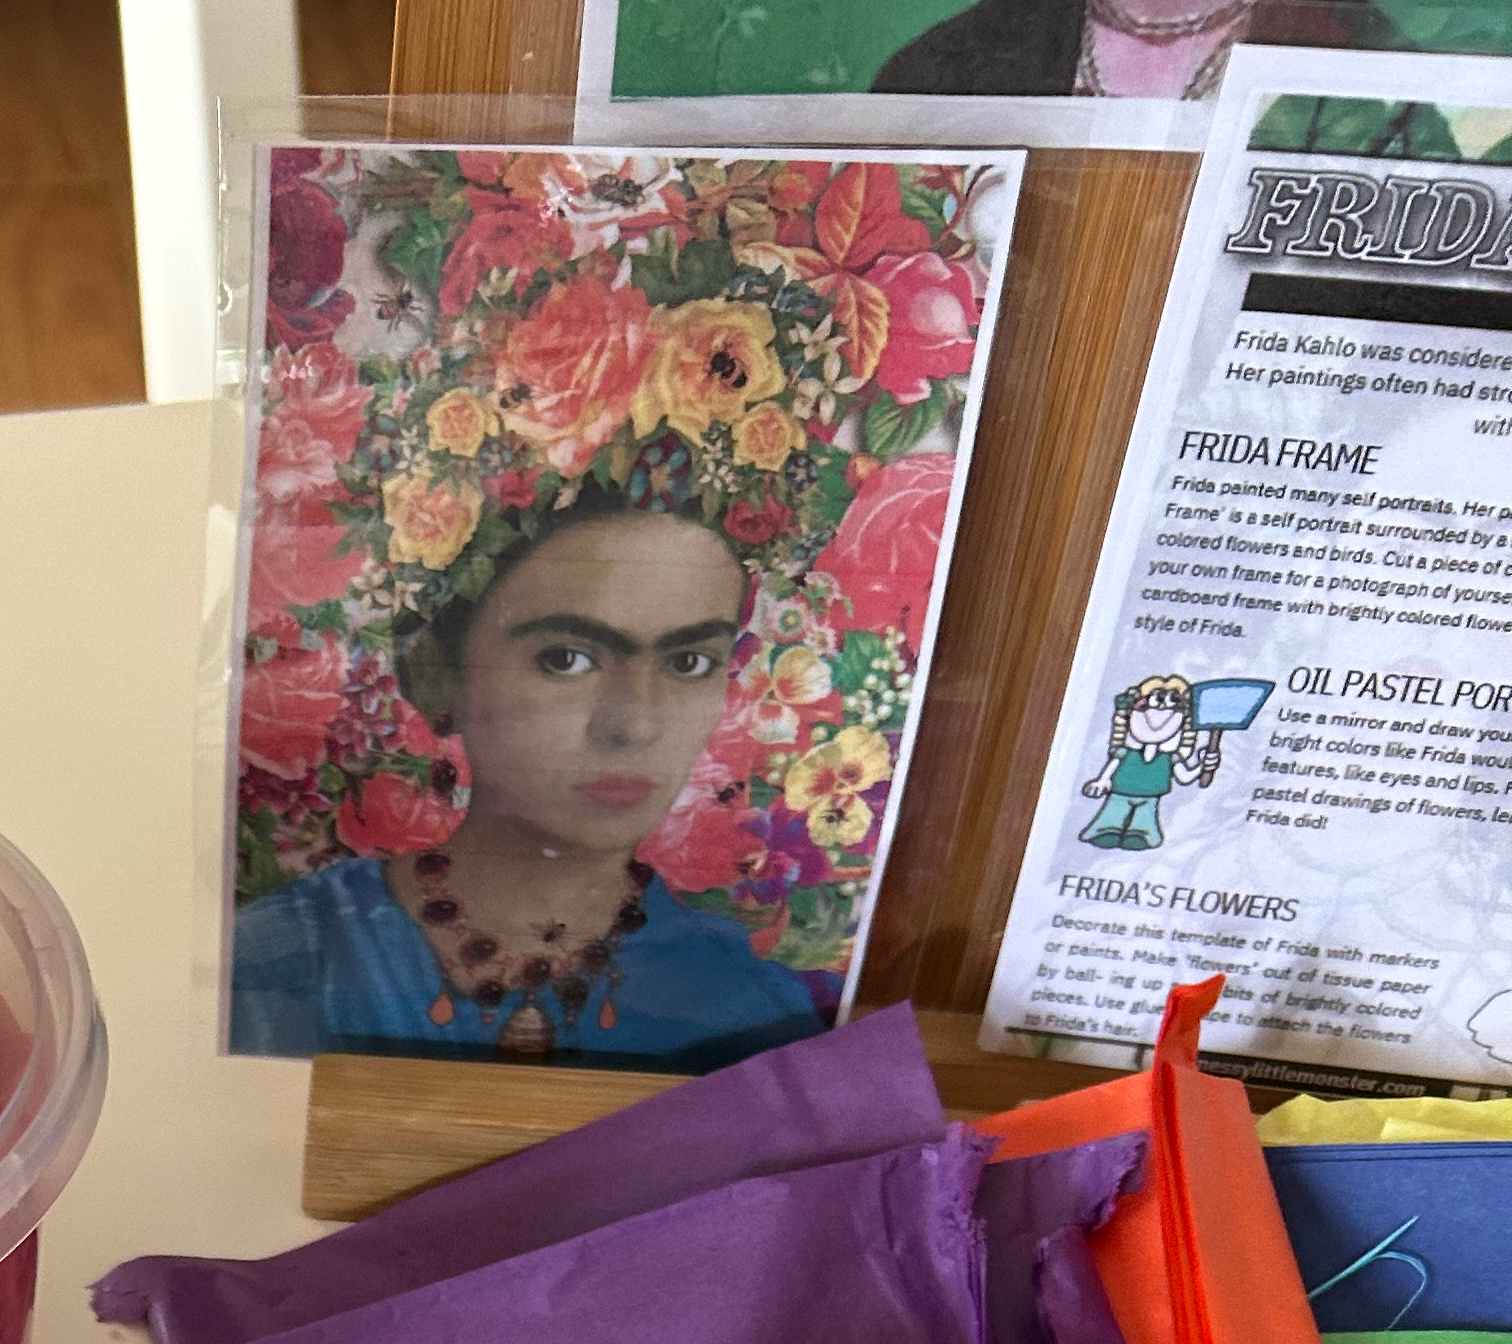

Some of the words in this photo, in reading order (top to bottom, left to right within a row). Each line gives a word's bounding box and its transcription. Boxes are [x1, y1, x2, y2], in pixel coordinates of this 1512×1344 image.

[1232, 329, 1288, 352] Frida
[1292, 335, 1356, 357] Kahlo
[1360, 343, 1405, 362] was
[1225, 362, 1266, 382] Her
[1267, 365, 1366, 395] paintings
[1370, 372, 1428, 395] often
[1431, 377, 1475, 399] had
[1177, 430, 1269, 466] FRIDA
[1274, 437, 1383, 475] FRAME
[1286, 666, 1333, 696] OIL
[1340, 669, 1444, 706] PASTEL
[1058, 874, 1166, 907] FRIDA'S
[1168, 886, 1300, 922] FLOWERS
